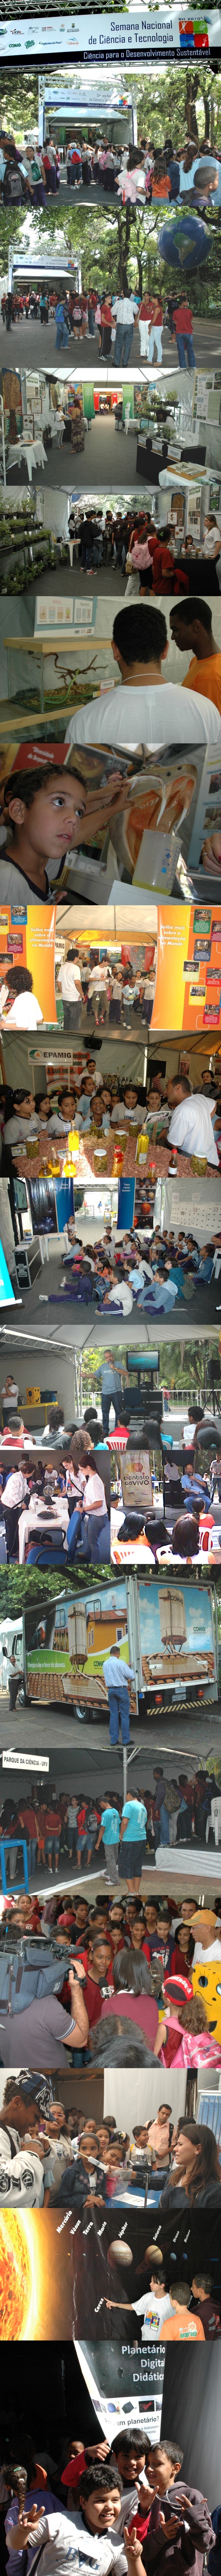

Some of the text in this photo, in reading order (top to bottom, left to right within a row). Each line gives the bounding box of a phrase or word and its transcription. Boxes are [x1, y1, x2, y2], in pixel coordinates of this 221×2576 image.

[111, 20, 172, 31] Semana Nacional
[89, 36, 97, 45] de
[99, 35, 125, 44] Ciência
[134, 32, 173, 43] Tecnologia
[126, 49, 175, 57] Desenvolvimento
[171, 1595, 183, 1604] CEMIG
[56, 2211, 72, 2233] Mercúrio
[70, 2219, 81, 2234] Vênus
[83, 2222, 94, 2235] Terra
[97, 2221, 107, 2236] Marte
[118, 2222, 128, 2238] Júpiter
[153, 2225, 162, 2241] Saturno
[94, 2298, 104, 2313] Ceres
[122, 2345, 165, 2354] Planetário
[141, 2358, 165, 2369] Digital
[133, 2372, 164, 2382] Didático
[127, 2416, 159, 2426] planetário?
